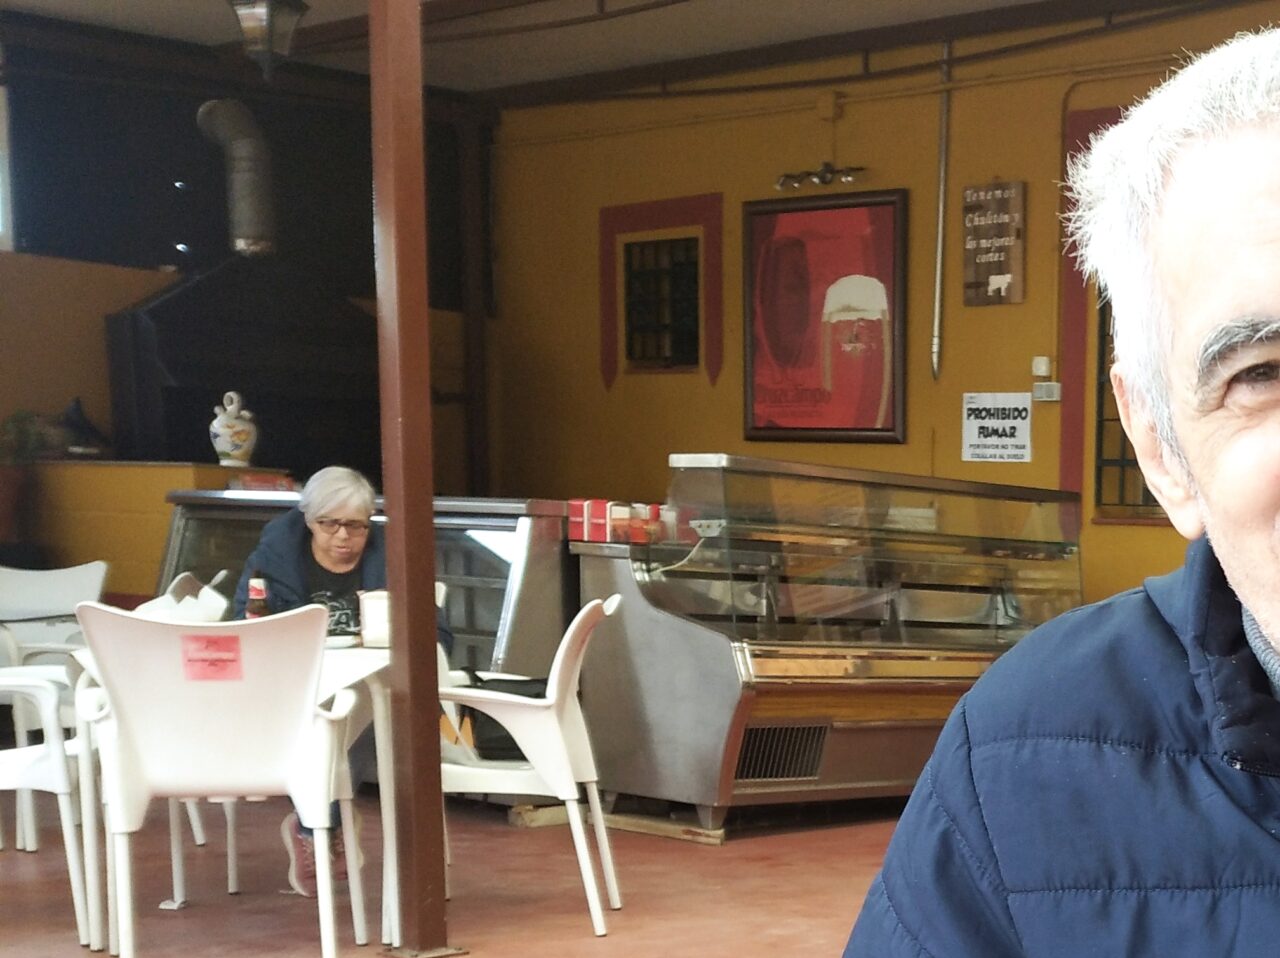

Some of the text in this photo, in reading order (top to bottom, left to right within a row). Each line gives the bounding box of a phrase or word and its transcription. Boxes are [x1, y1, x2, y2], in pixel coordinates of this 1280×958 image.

[976, 252, 1006, 263] cortes
[966, 407, 1029, 420] PROHIBIDO
[977, 425, 1017, 438] FUMAR
